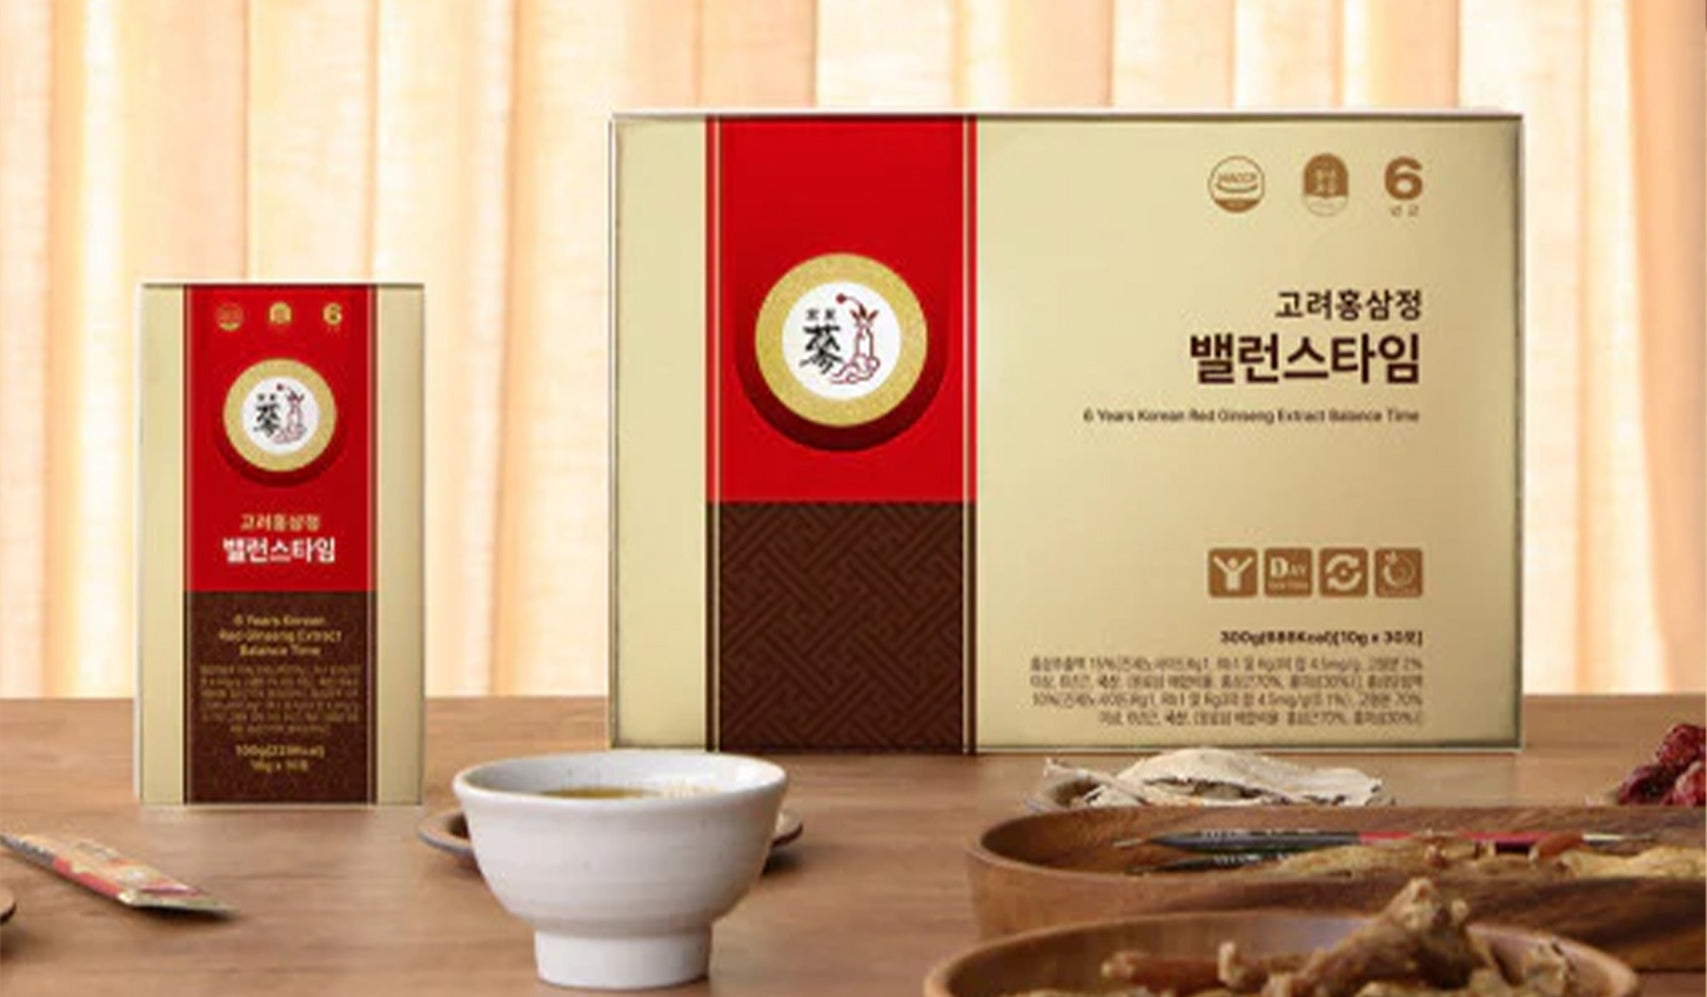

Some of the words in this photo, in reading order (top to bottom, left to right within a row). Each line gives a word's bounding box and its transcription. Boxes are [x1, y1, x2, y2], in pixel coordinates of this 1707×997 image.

[1385, 156, 1423, 201] 6
[323, 302, 343, 326] 6
[1275, 289, 1422, 321] 고려홍삼정
[1190, 333, 1420, 384] 밸런스타임
[1097, 407, 1134, 424] Years
[1138, 407, 1184, 424] Korean
[1189, 407, 1215, 424] Red
[1218, 407, 1275, 424] Ginseng
[1277, 407, 1326, 424] Extract
[1329, 407, 1382, 424] Balance
[1386, 407, 1419, 424] Time
[241, 514, 321, 531] 고려홍삼정
[222, 537, 336, 563] 밸런스타임
